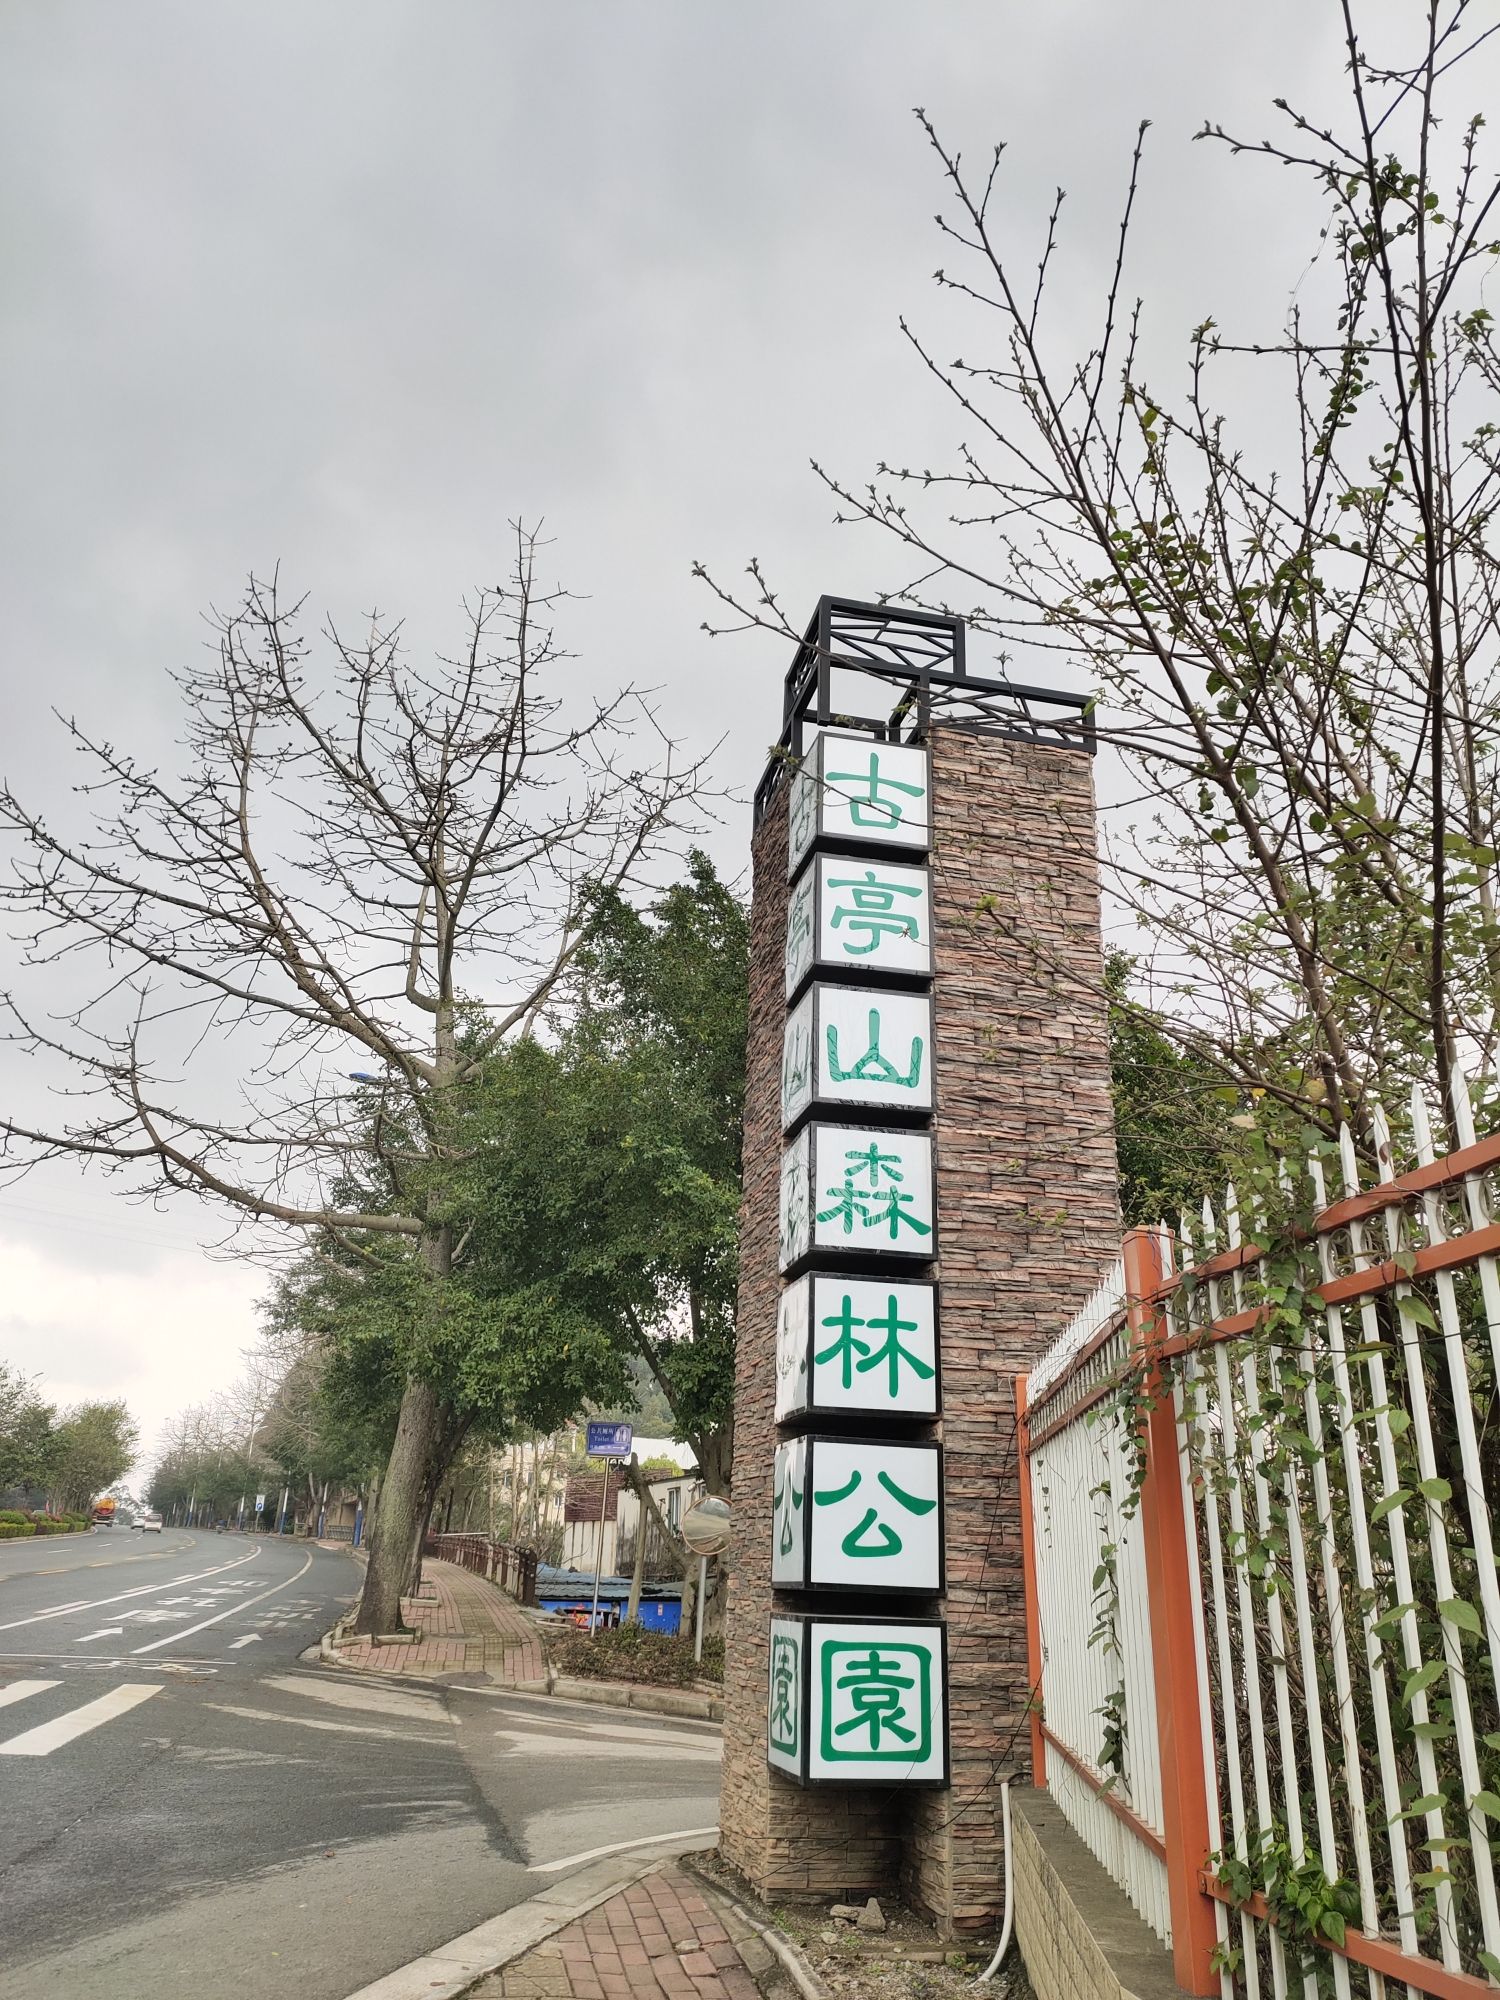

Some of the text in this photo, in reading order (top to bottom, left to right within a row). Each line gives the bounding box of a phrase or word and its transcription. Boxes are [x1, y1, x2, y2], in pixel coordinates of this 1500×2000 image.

[814, 752, 936, 1763] 古亭山森林公園
